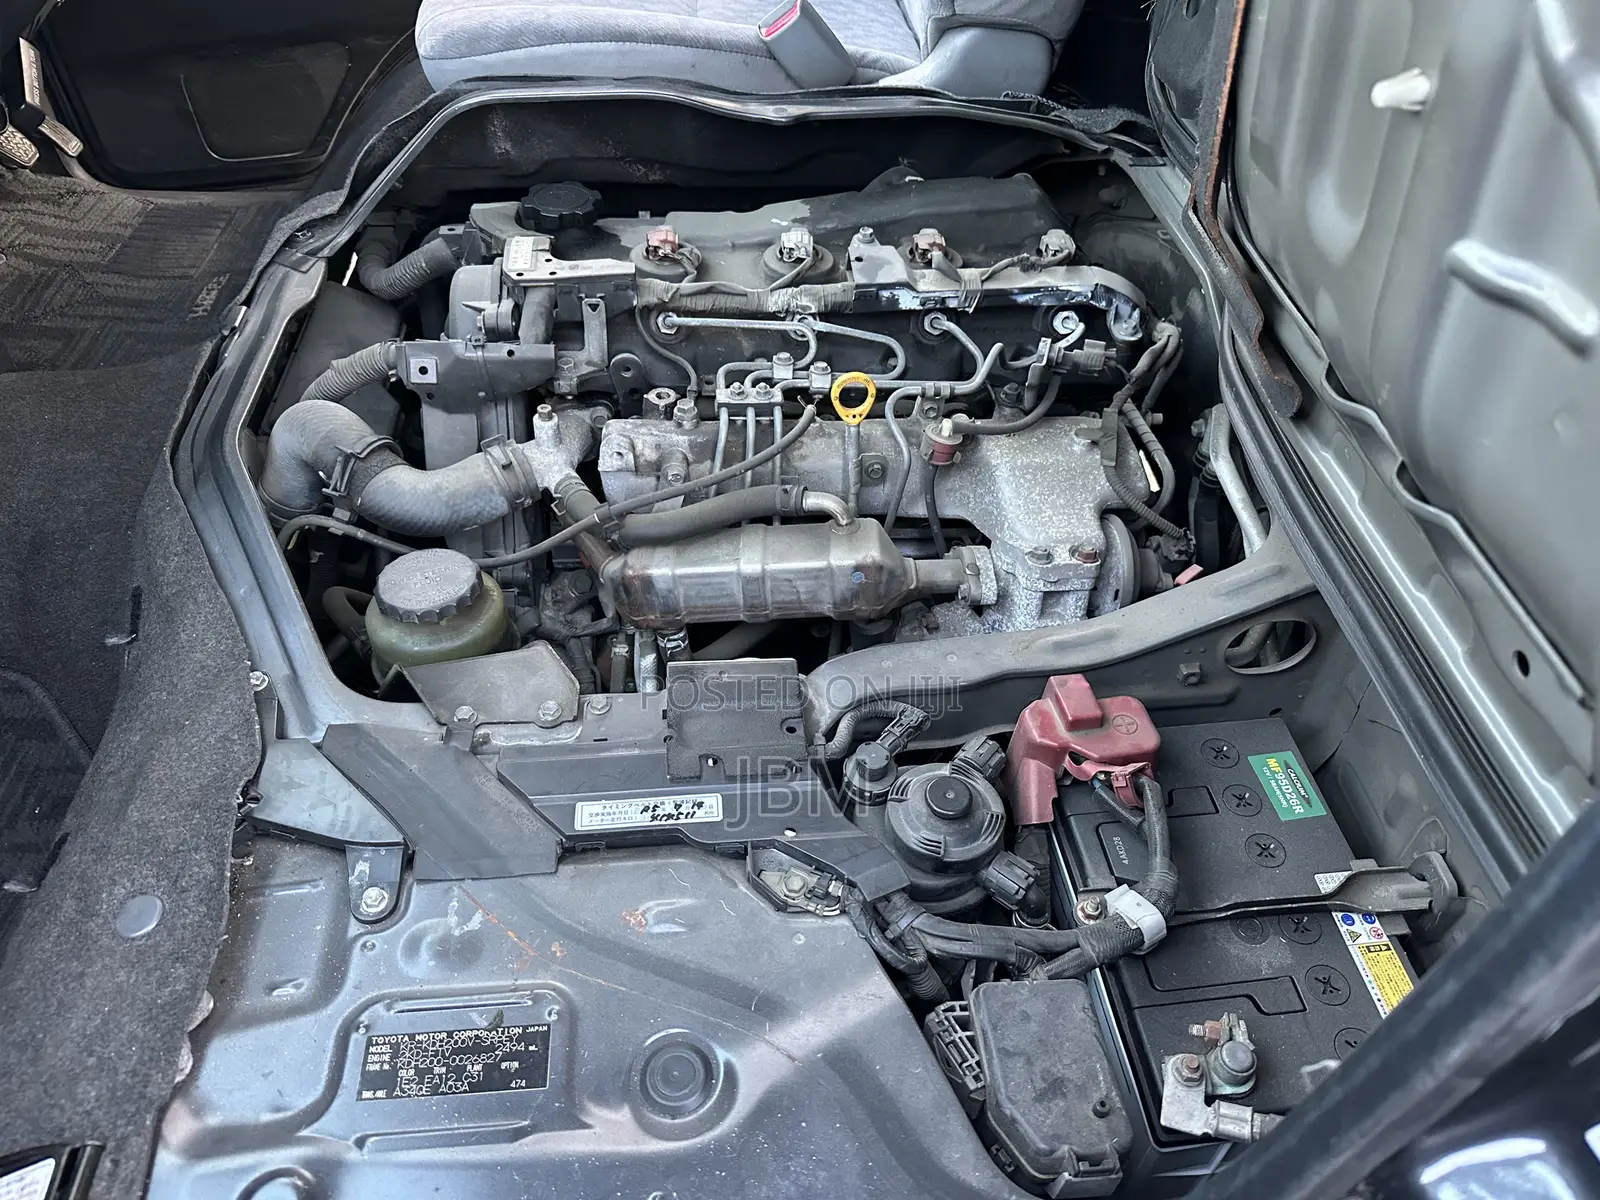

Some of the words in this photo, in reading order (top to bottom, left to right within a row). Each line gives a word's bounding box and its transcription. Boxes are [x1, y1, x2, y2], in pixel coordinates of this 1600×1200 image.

[1265, 757, 1305, 814] MF95D26R
[371, 1034, 410, 1045] TOYOTA
[415, 1032, 448, 1042] MOTOR
[453, 1026, 523, 1039] CORPORATION
[526, 1025, 548, 1033] JAPAN
[367, 1053, 392, 1063] ENGINE
[399, 1046, 453, 1061] 2KD-FTV
[495, 1041, 526, 1053] 2494
[369, 1044, 393, 1054] MODEL
[396, 1051, 503, 1069] KDH200-0026827
[398, 1068, 416, 1077] COLOR
[467, 1064, 484, 1072] PLANT
[510, 1079, 526, 1088] 474
